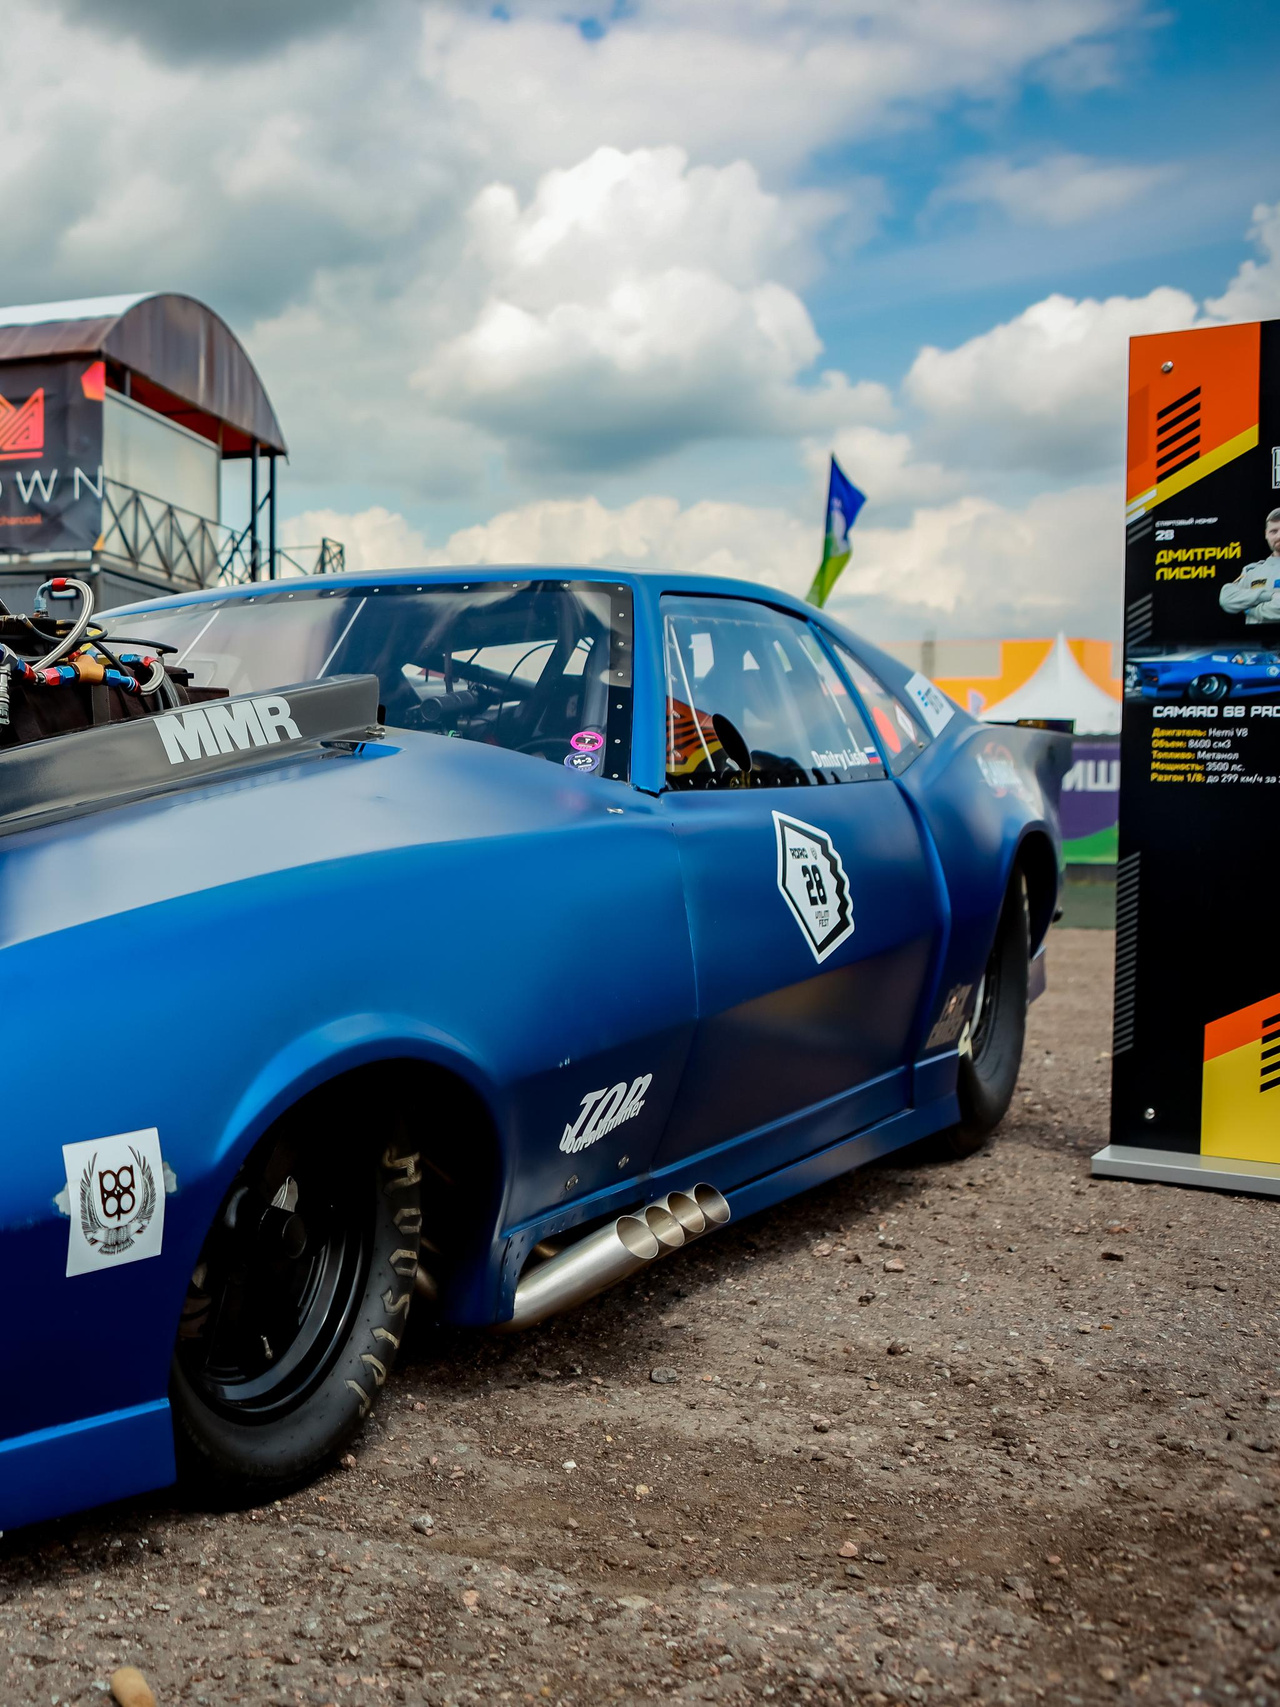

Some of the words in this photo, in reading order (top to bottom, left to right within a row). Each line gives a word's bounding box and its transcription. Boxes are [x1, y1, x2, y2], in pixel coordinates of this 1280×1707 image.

[1155, 529, 1174, 541] 28
[1155, 541, 1241, 565] ДМИТРИЙ
[1155, 565, 1216, 581] ЛИСИН
[1152, 705, 1218, 717] CAMARO
[1223, 705, 1246, 717] 68
[153, 696, 302, 764] MMR
[1208, 727, 1234, 737] Hemi
[1235, 727, 1248, 737] V8
[810, 750, 847, 770] Dmitry
[1197, 751, 1239, 760] Метанол
[1206, 775, 1219, 783] до
[1240, 773, 1263, 784] км/ч
[801, 864, 828, 906] 28
[572, 1073, 652, 1138] TOP
